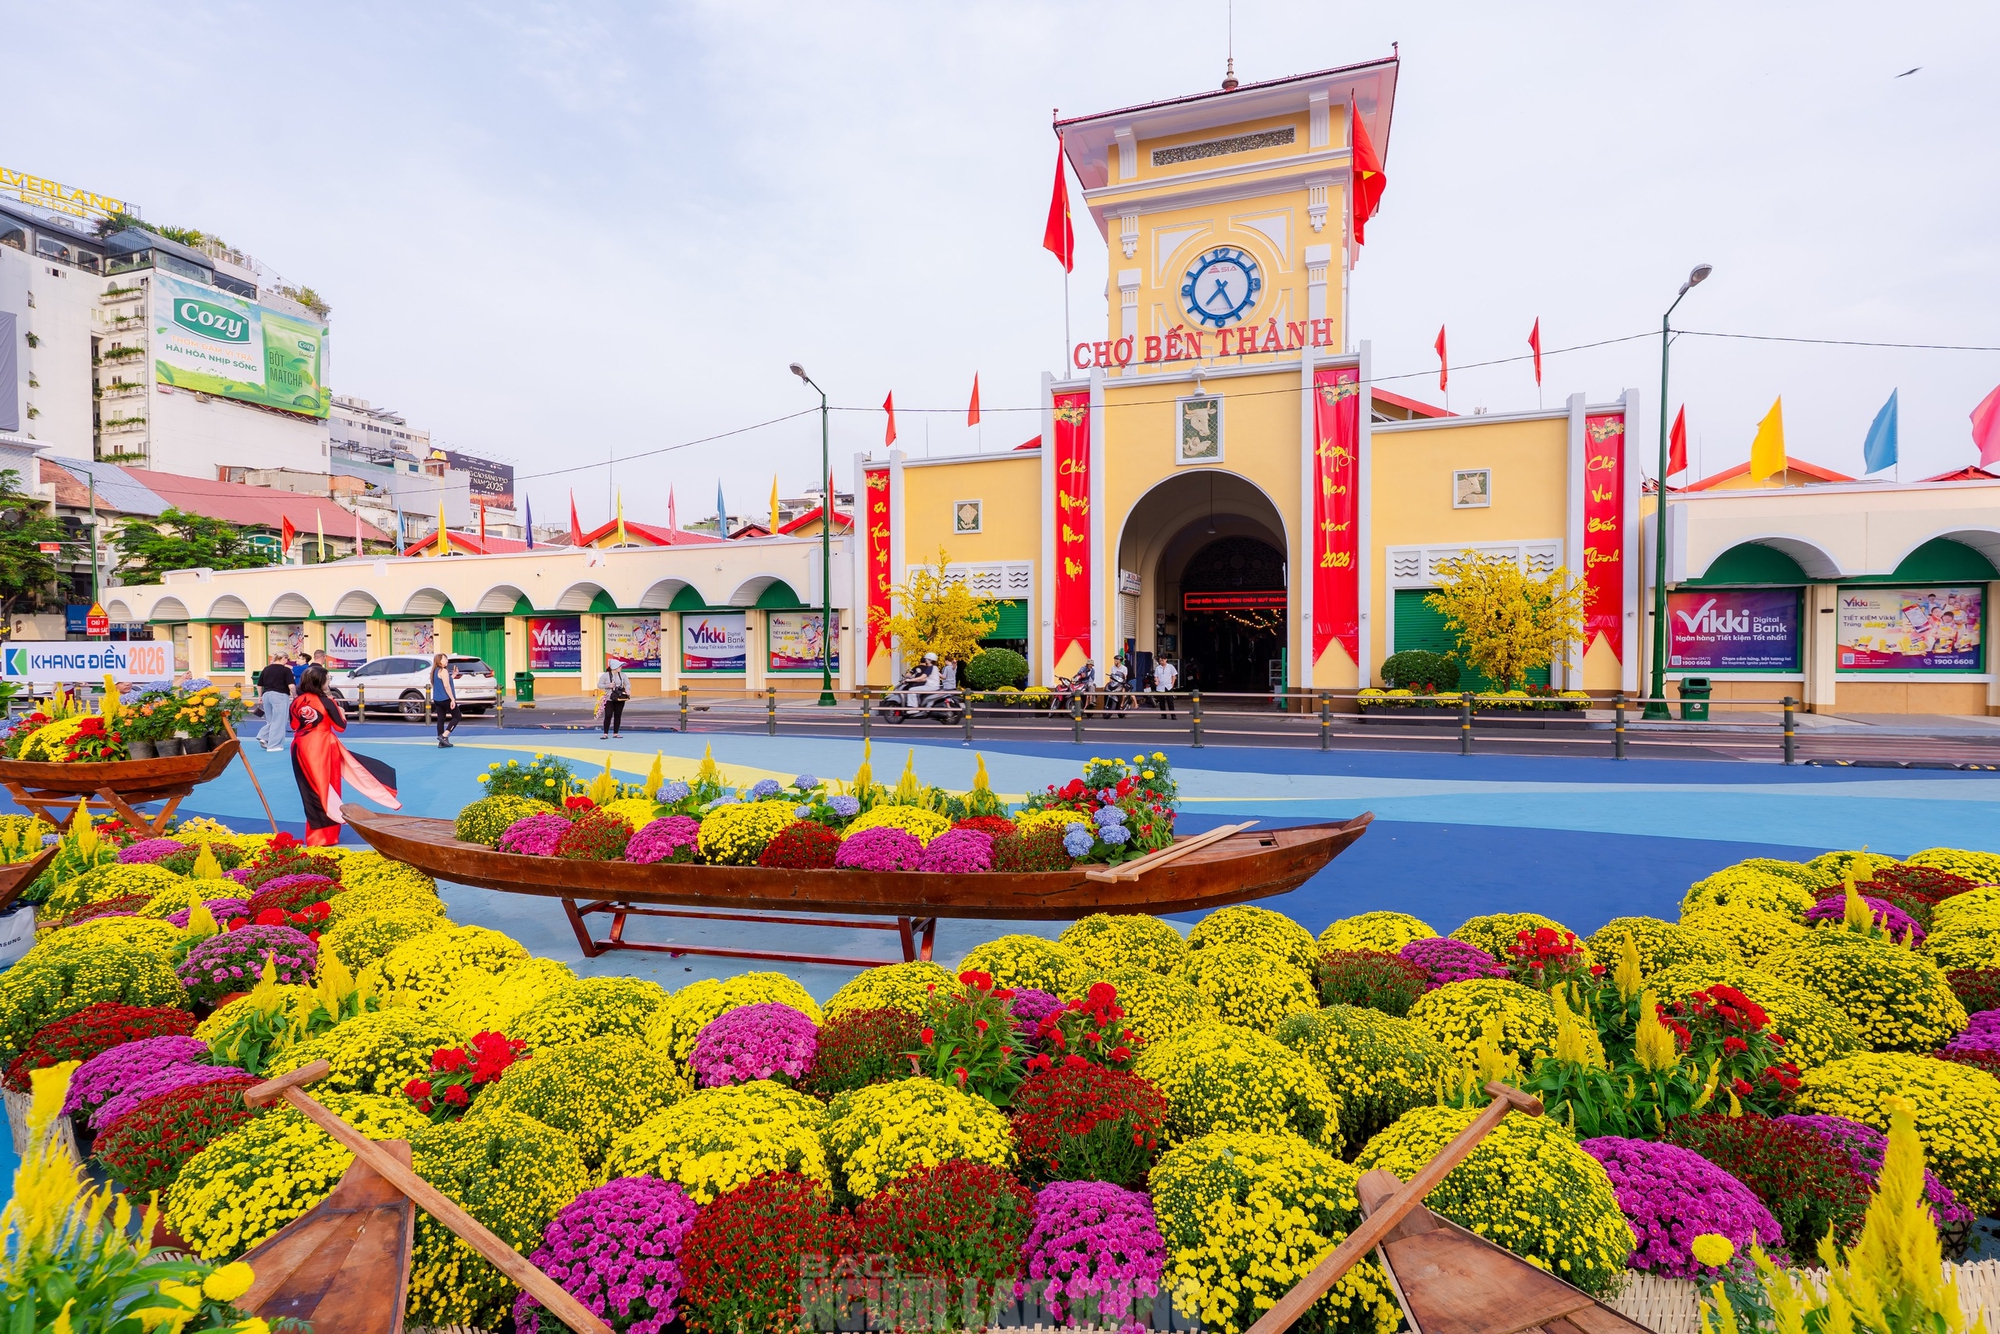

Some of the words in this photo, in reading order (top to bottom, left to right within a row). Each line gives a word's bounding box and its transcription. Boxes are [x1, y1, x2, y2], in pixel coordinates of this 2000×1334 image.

[1213, 248, 1230, 260] 12
[1181, 284, 1192, 296] 9
[1250, 278, 1261, 291] 3
[1215, 317, 1226, 328] 6
[1074, 335, 1134, 369] CHỢ
[1144, 324, 1204, 363] BẾN
[1216, 317, 1334, 356] THÀNH
[209, 354, 230, 365] NHỊP
[233, 360, 257, 372] SỐNG
[270, 367, 302, 388] MATCHA
[1315, 437, 1356, 473] Happy
[1587, 455, 1616, 472] Chợ
[1059, 458, 1087, 475] Chúc
[485, 480, 504, 492] 2025
[1591, 483, 1613, 503] Vui
[1587, 515, 1616, 533] Bến
[1320, 550, 1350, 568] 2026
[1583, 547, 1619, 568] Thành
[1843, 596, 1868, 607] Vikki
[1676, 598, 1750, 633] Vikki
[330, 626, 358, 648] Vikki
[532, 622, 566, 645] Vikki
[688, 619, 725, 643] Vikki
[1753, 623, 1787, 633] Bank
[215, 628, 241, 649] Vikki
[1696, 634, 1715, 642] hàng
[1733, 634, 1751, 642] kiệm
[31, 655, 85, 669] KHANG
[88, 645, 126, 669] ĐIỀN
[129, 647, 165, 675] 2026
